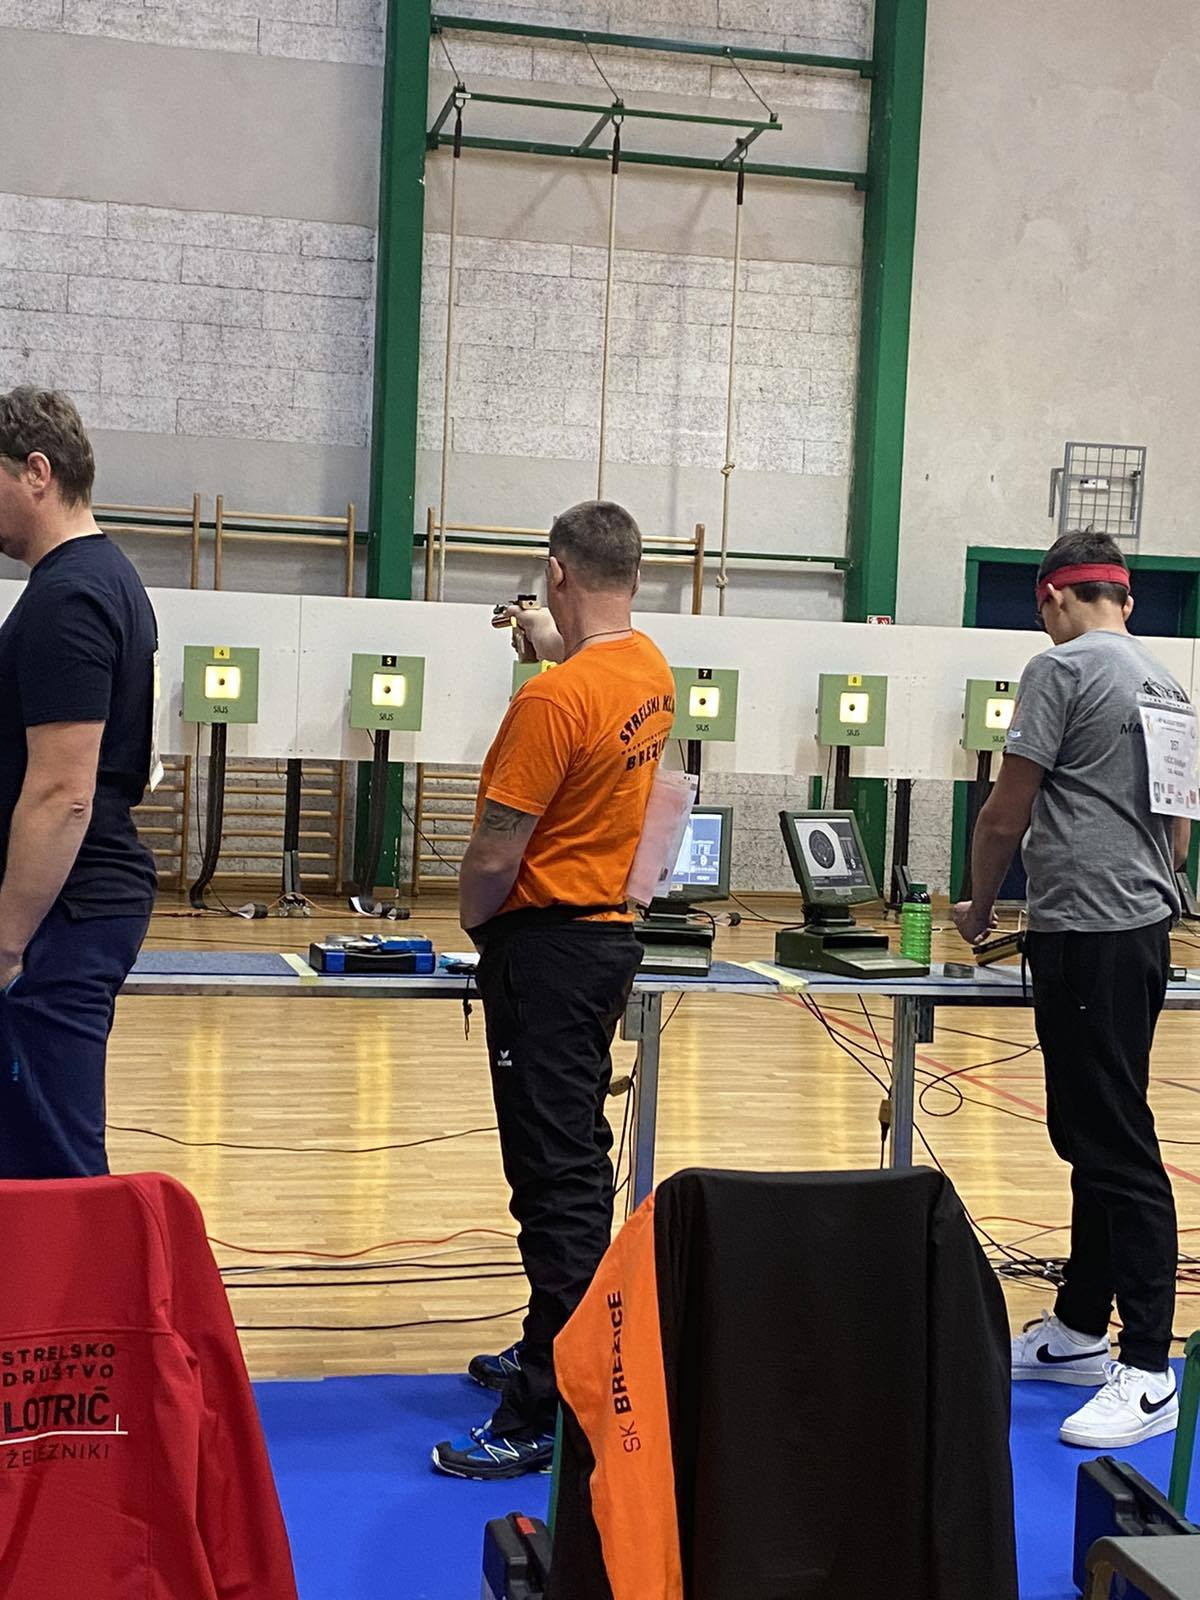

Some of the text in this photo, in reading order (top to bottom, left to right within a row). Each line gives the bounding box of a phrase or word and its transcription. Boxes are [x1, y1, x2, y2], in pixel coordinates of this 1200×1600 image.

[620, 695, 660, 746] STRELSKI
[1120, 722, 1144, 735] MA
[2, 1343, 116, 1366] STRELSKO
[2, 1364, 115, 1387] DRUŠTVO
[3, 1387, 110, 1434] LOTRIČ
[619, 1421, 641, 1453] SK
